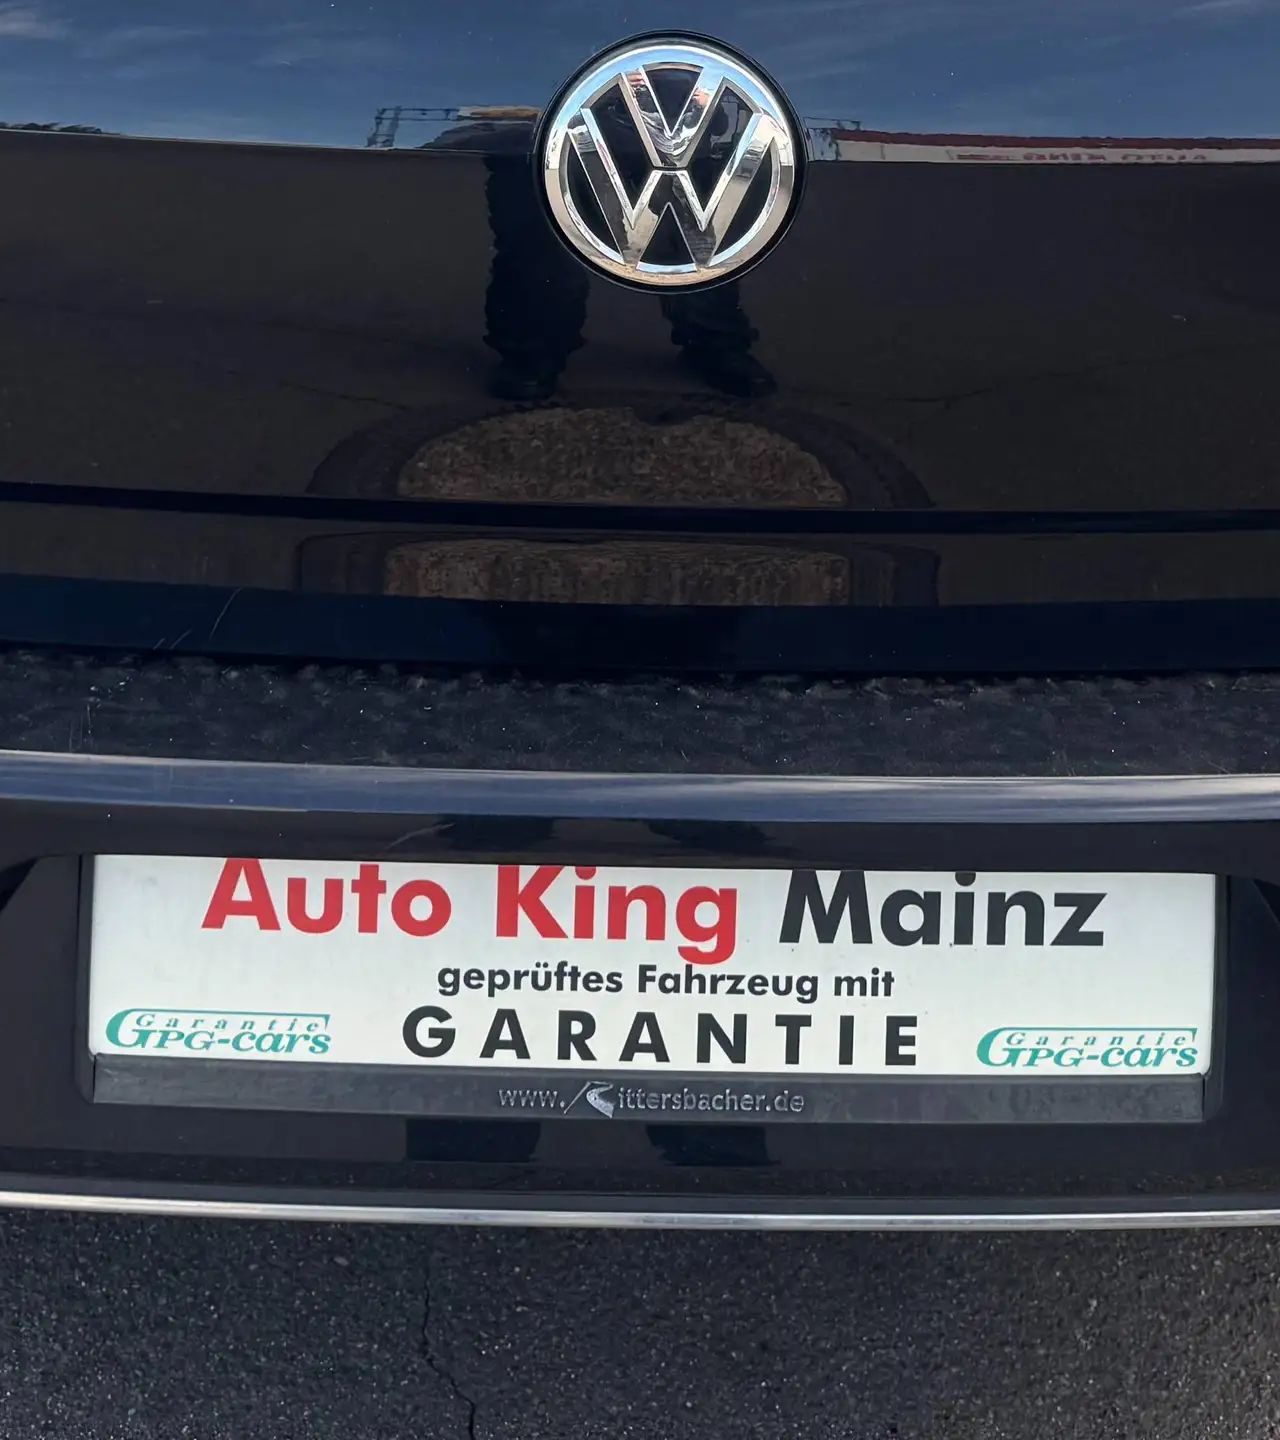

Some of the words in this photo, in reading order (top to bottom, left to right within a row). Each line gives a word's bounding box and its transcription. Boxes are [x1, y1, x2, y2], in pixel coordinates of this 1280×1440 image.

[202, 857, 452, 937] Auto
[496, 864, 738, 965] King
[779, 870, 1107, 947] Mainz
[437, 959, 623, 998] geprüftes
[638, 964, 819, 1004] Fahrzeug
[834, 968, 895, 997] mit
[402, 1005, 918, 1067] GARANTIE
